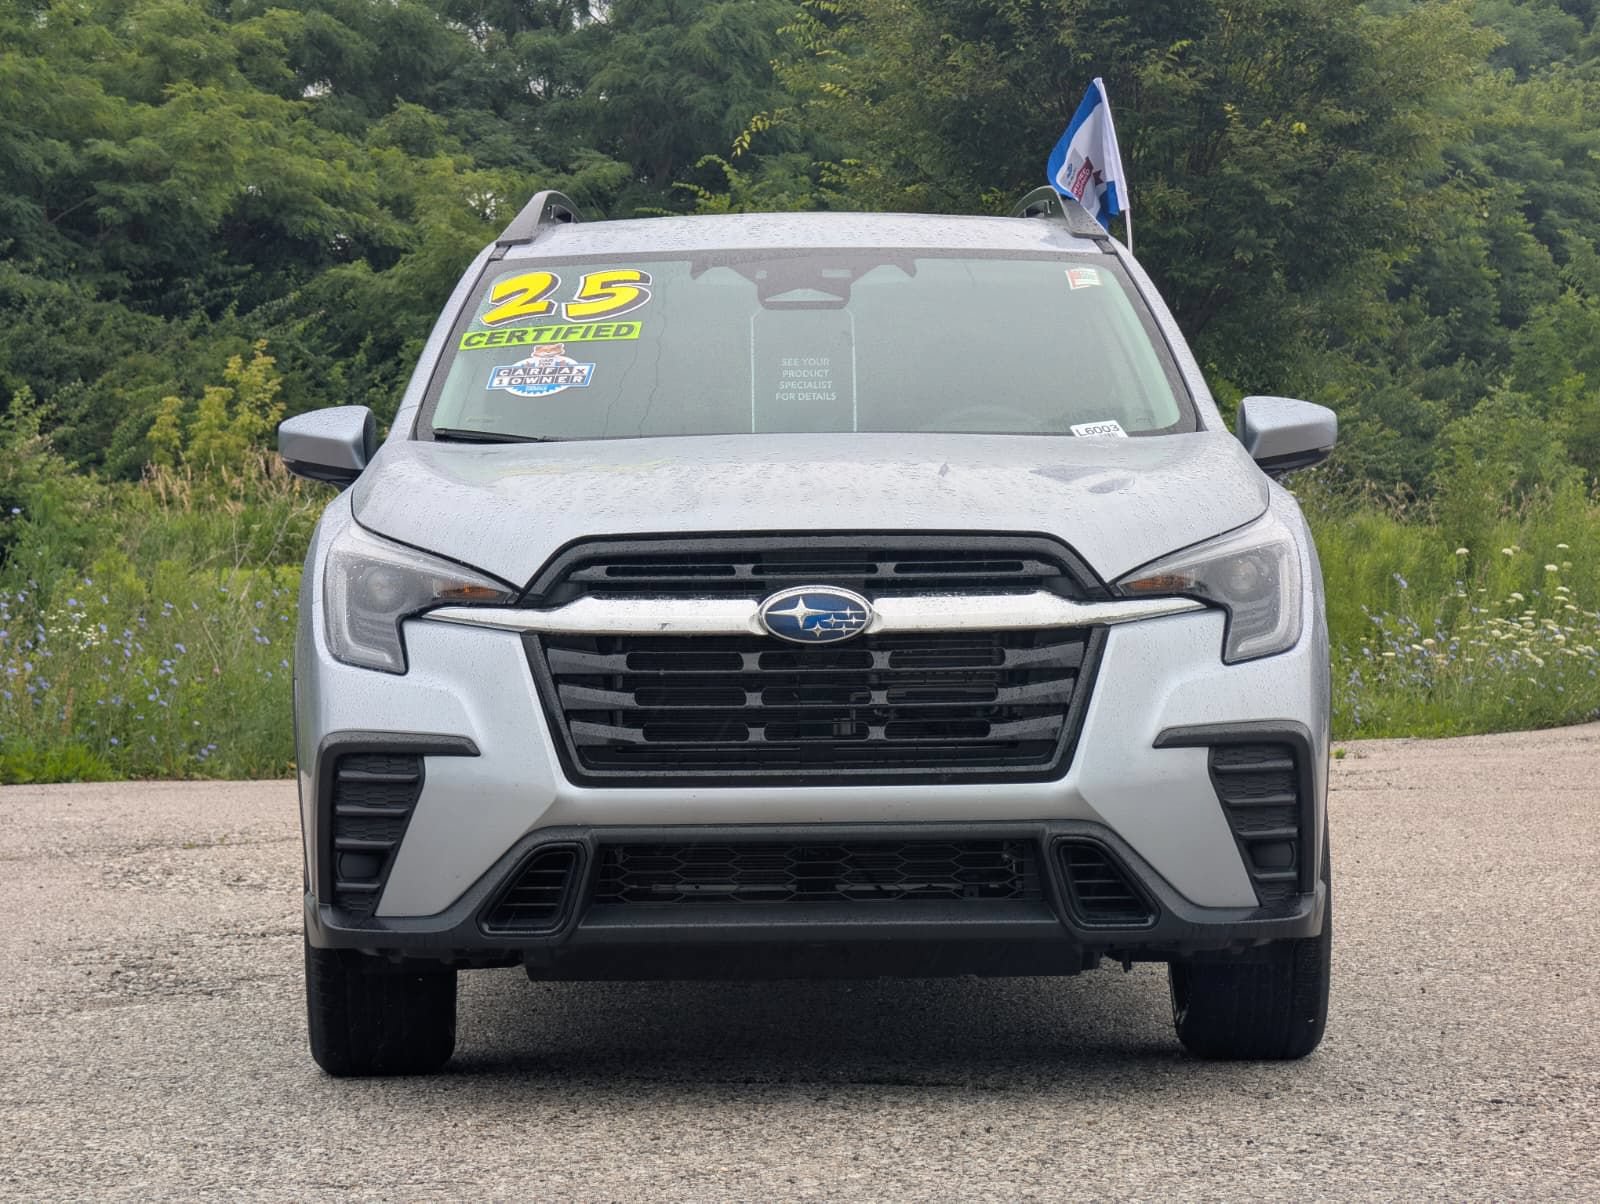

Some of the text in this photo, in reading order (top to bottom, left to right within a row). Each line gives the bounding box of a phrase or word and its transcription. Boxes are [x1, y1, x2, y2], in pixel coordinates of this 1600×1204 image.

[480, 269, 652, 327] 25
[464, 323, 635, 347] CERTIFIED
[782, 358, 830, 366] SEE YOUR
[499, 367, 585, 376] CARFAX
[782, 369, 830, 377] PRODUCT
[511, 376, 583, 385] OWNER
[779, 381, 832, 389] SPECIALIST
[776, 392, 837, 400] FOR DETAILS
[1075, 425, 1120, 437] L6003
